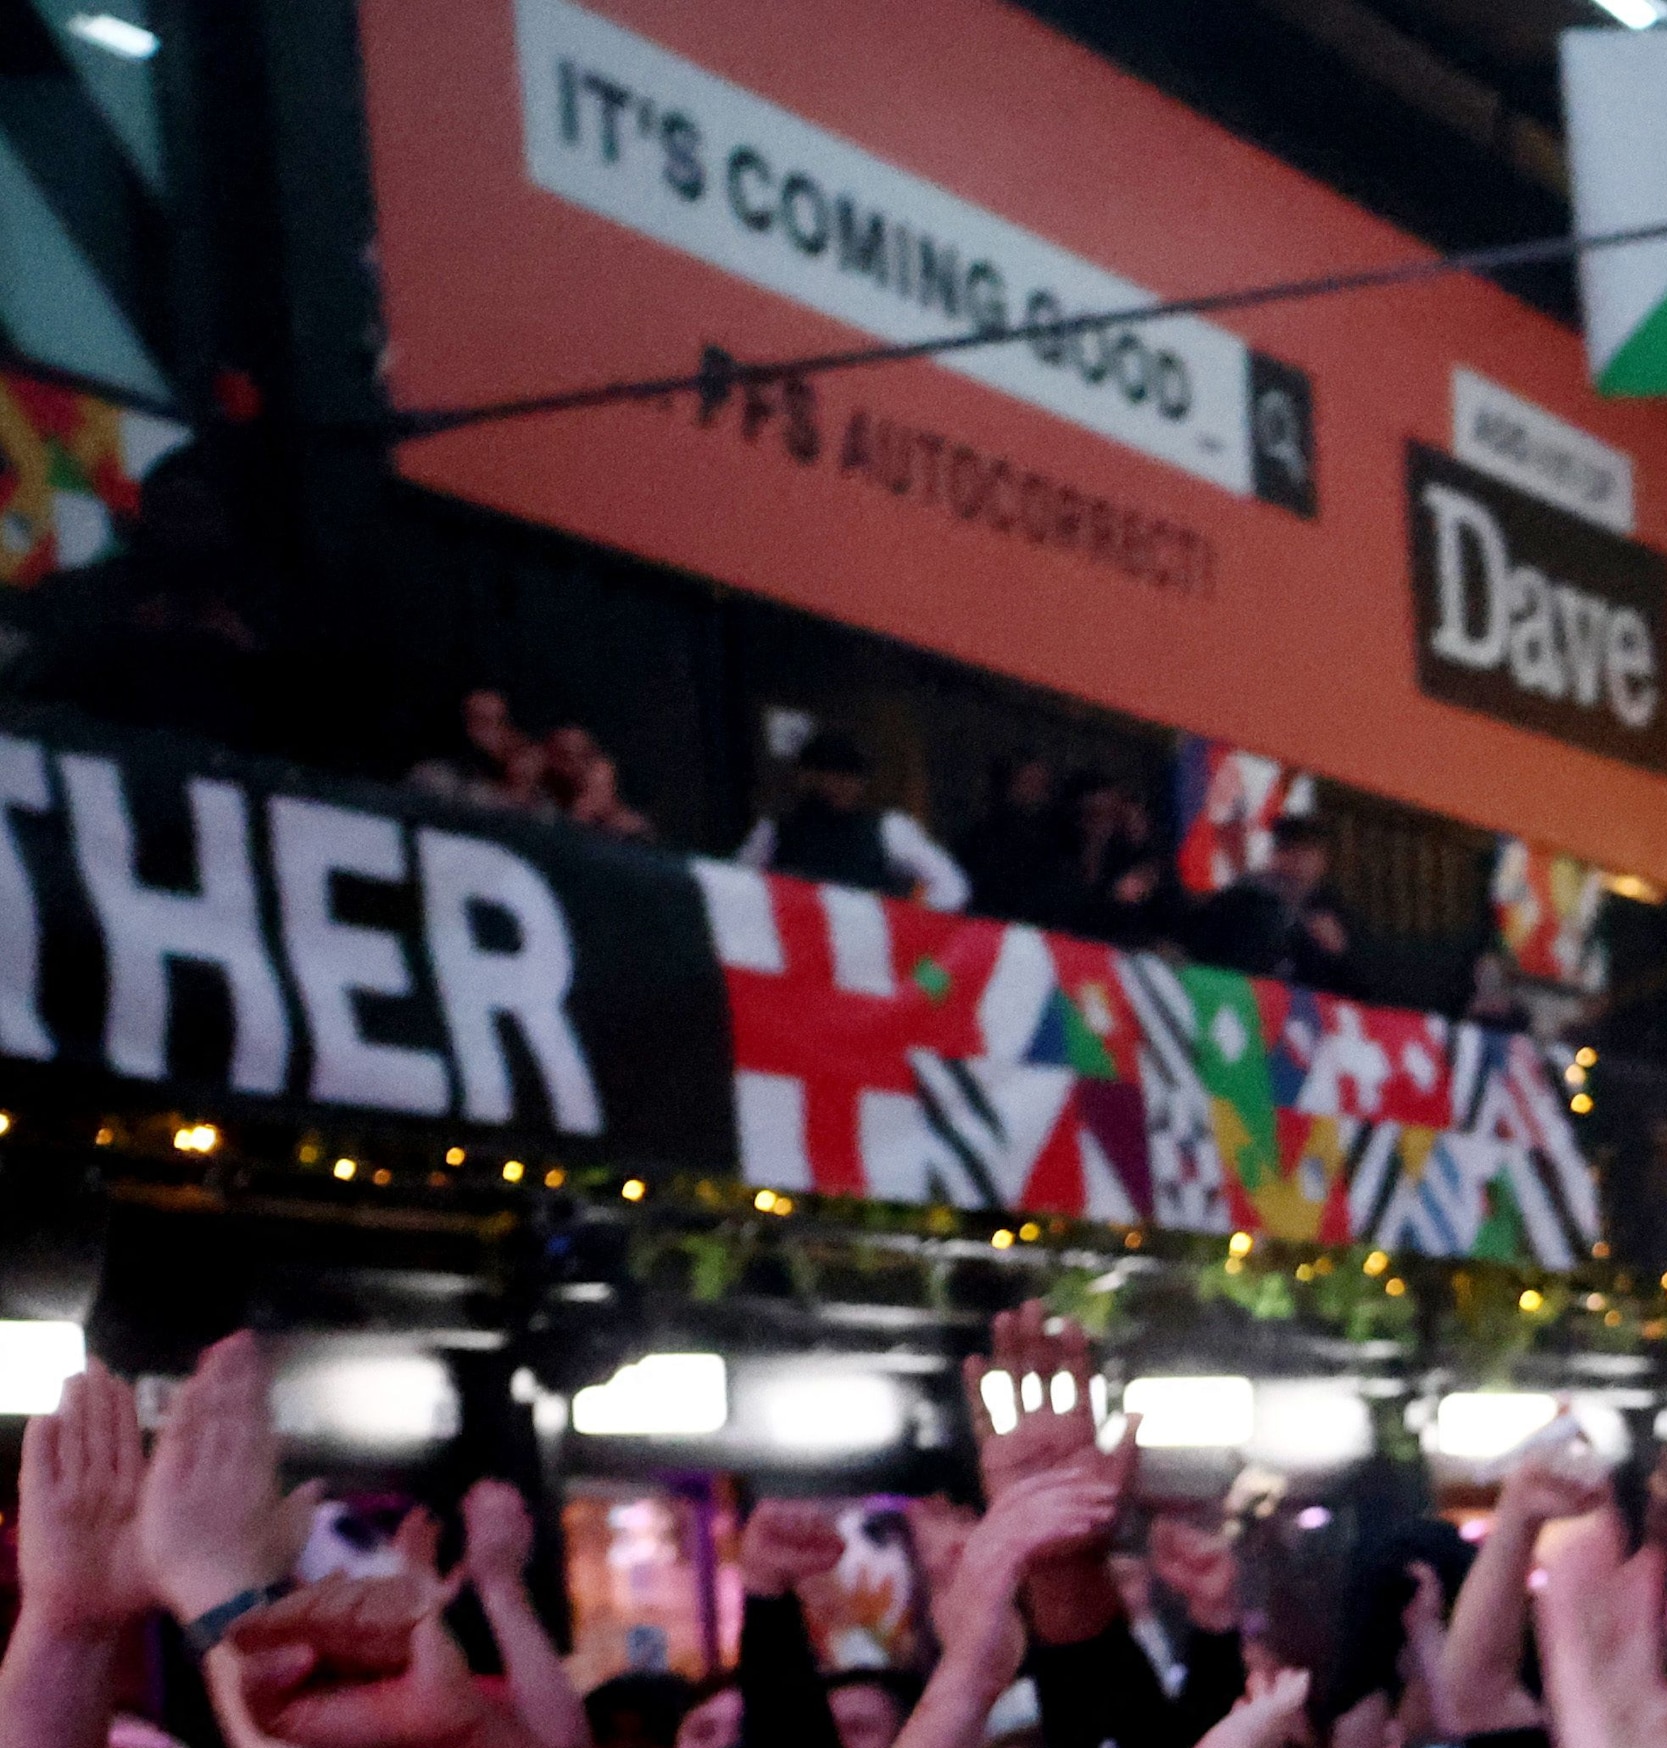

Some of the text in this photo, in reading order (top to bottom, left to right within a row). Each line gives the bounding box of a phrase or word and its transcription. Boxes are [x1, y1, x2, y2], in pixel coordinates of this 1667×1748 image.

[557, 58, 707, 203] IT'S
[726, 143, 1005, 335] COMING
[1424, 484, 1657, 729] Dave
